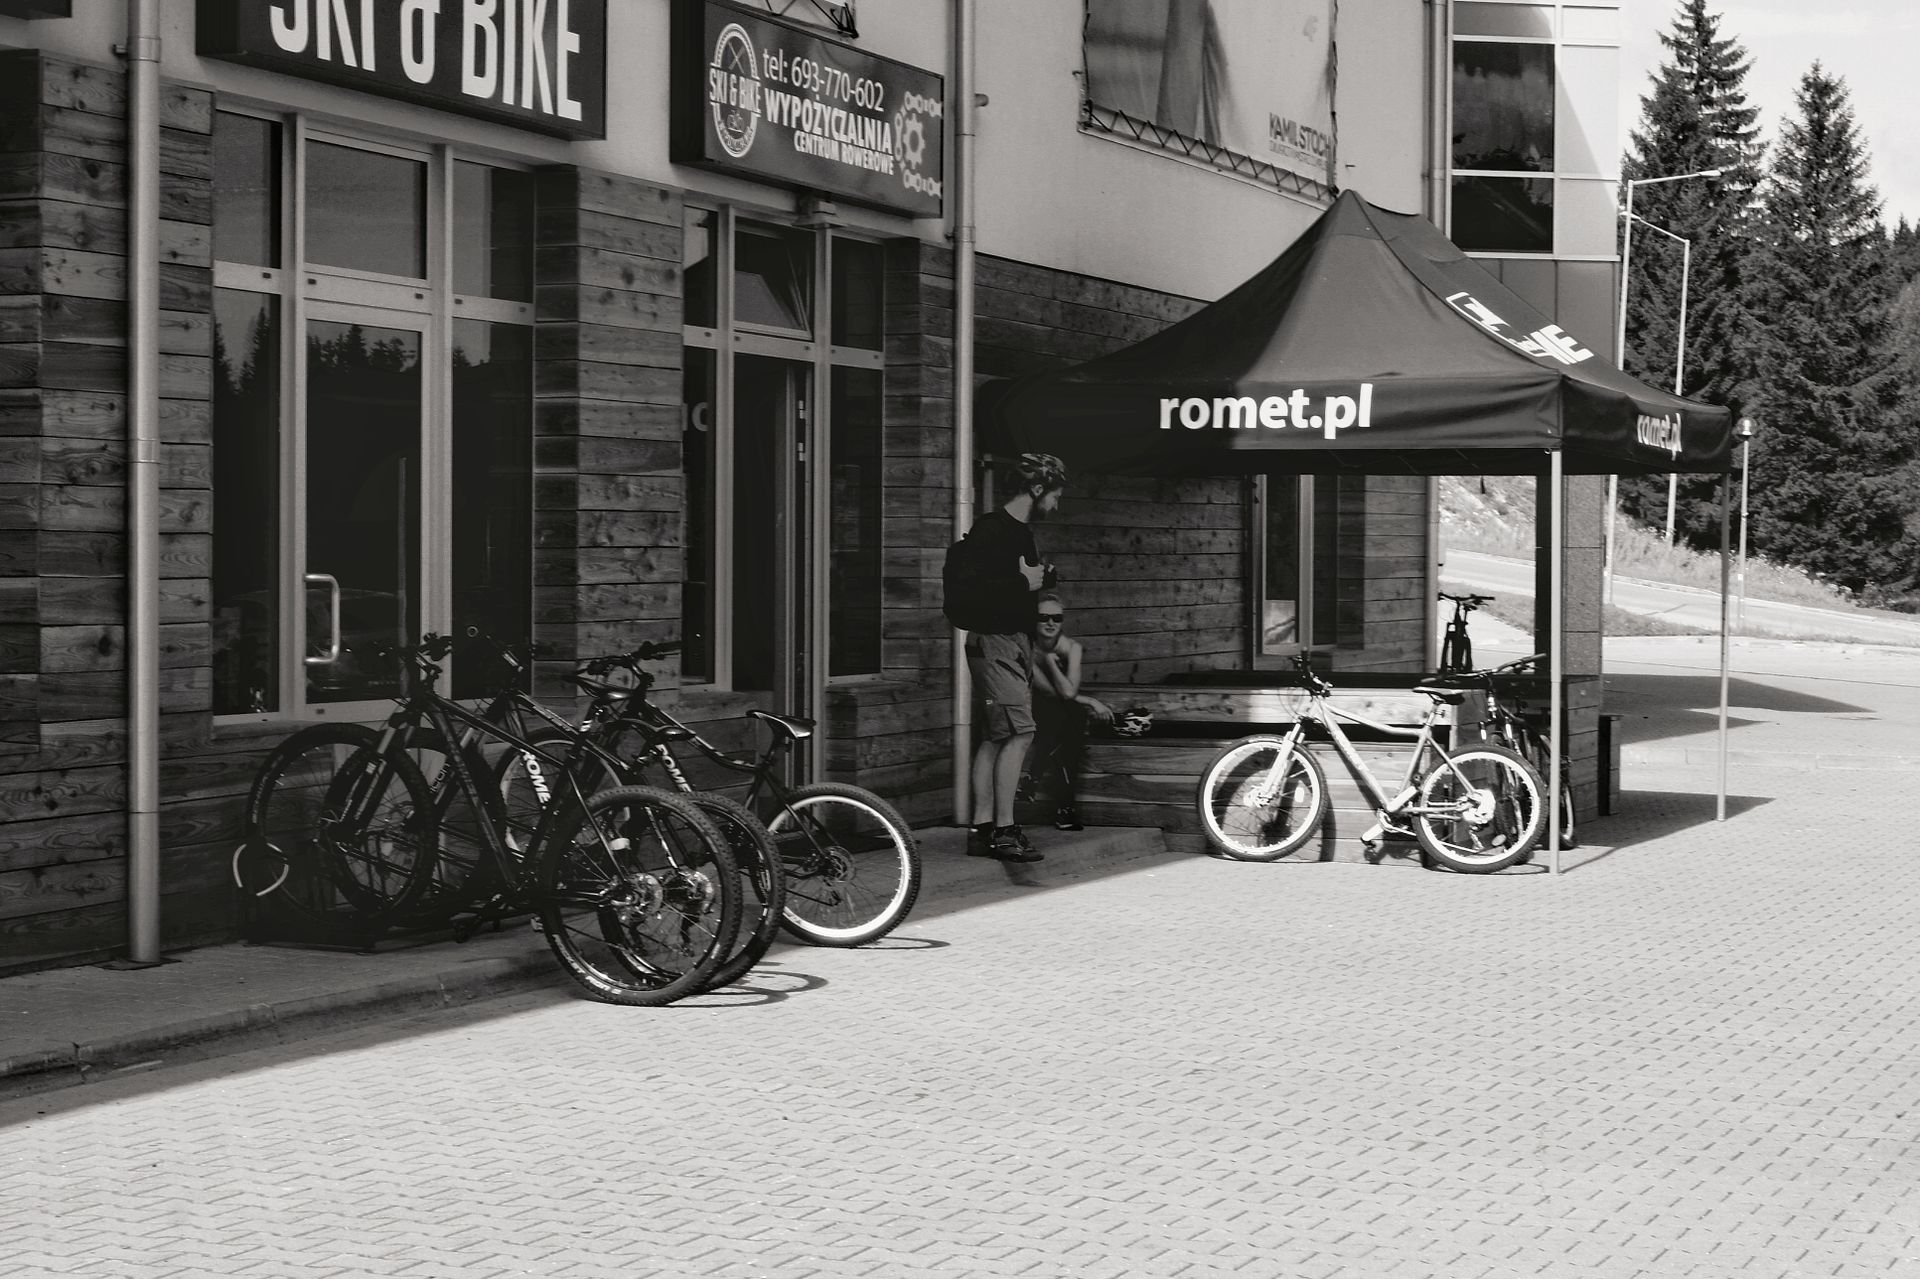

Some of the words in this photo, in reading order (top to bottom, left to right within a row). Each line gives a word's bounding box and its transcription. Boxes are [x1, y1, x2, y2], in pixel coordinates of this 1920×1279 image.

[400, 0, 440, 84] &
[461, 0, 583, 121] BIKE
[709, 67, 727, 104] SKI
[729, 73, 738, 106] &
[739, 75, 762, 114] BIKE
[763, 48, 788, 84] tel:
[791, 56, 885, 112] 693-770-602
[764, 87, 893, 154] WYPOŻYCZALNIA
[794, 130, 840, 162] CENTRUM
[841, 144, 895, 176] ROWEROWE
[1159, 383, 1373, 440] romet.pl
